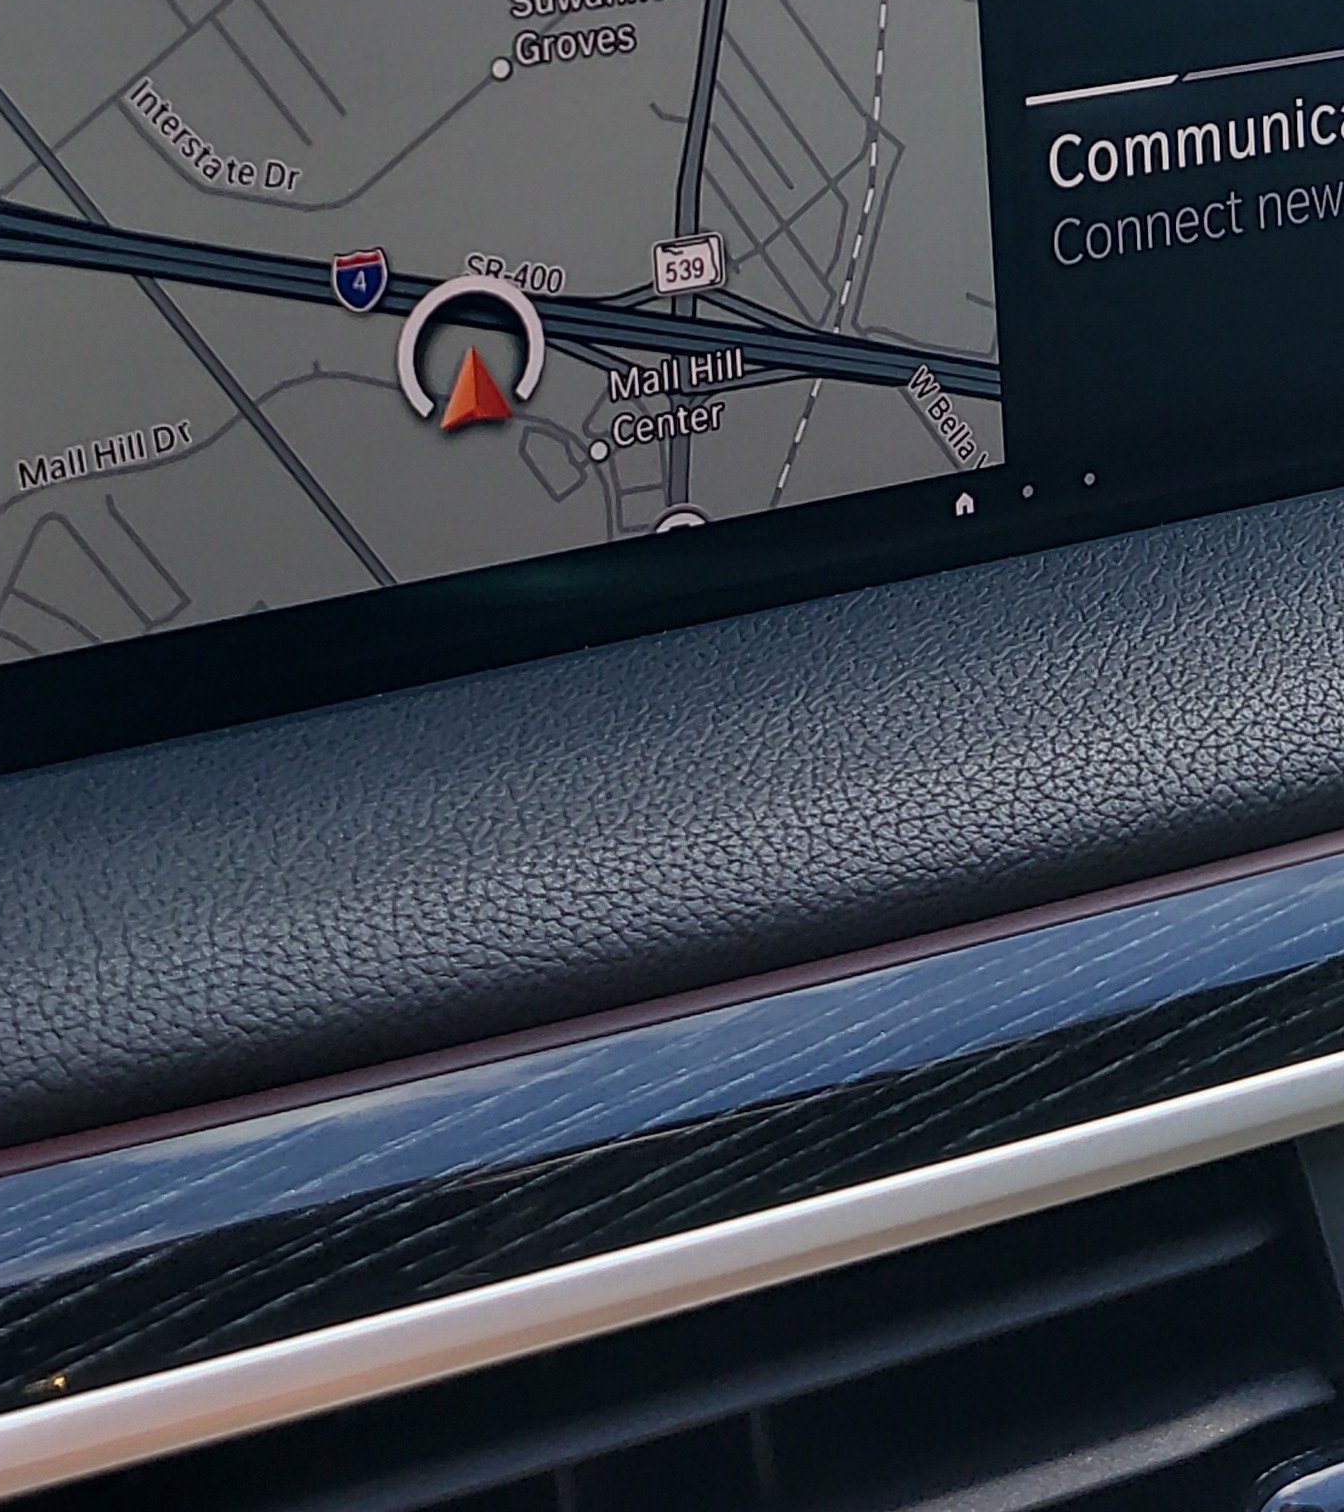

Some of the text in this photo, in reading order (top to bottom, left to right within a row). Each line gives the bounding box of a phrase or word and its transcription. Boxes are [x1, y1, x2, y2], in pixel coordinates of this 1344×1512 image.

[515, 23, 637, 66] Groves
[129, 79, 301, 191] Interstate Dr
[1051, 190, 1243, 266] Connect
[1258, 182, 1344, 231] new
[353, 270, 367, 293] 4
[665, 257, 704, 283] 539
[610, 349, 744, 399] Mall Hill
[611, 401, 724, 446] Center
[909, 366, 976, 462] W Bella
[18, 421, 193, 489] Mall Hill Dr
